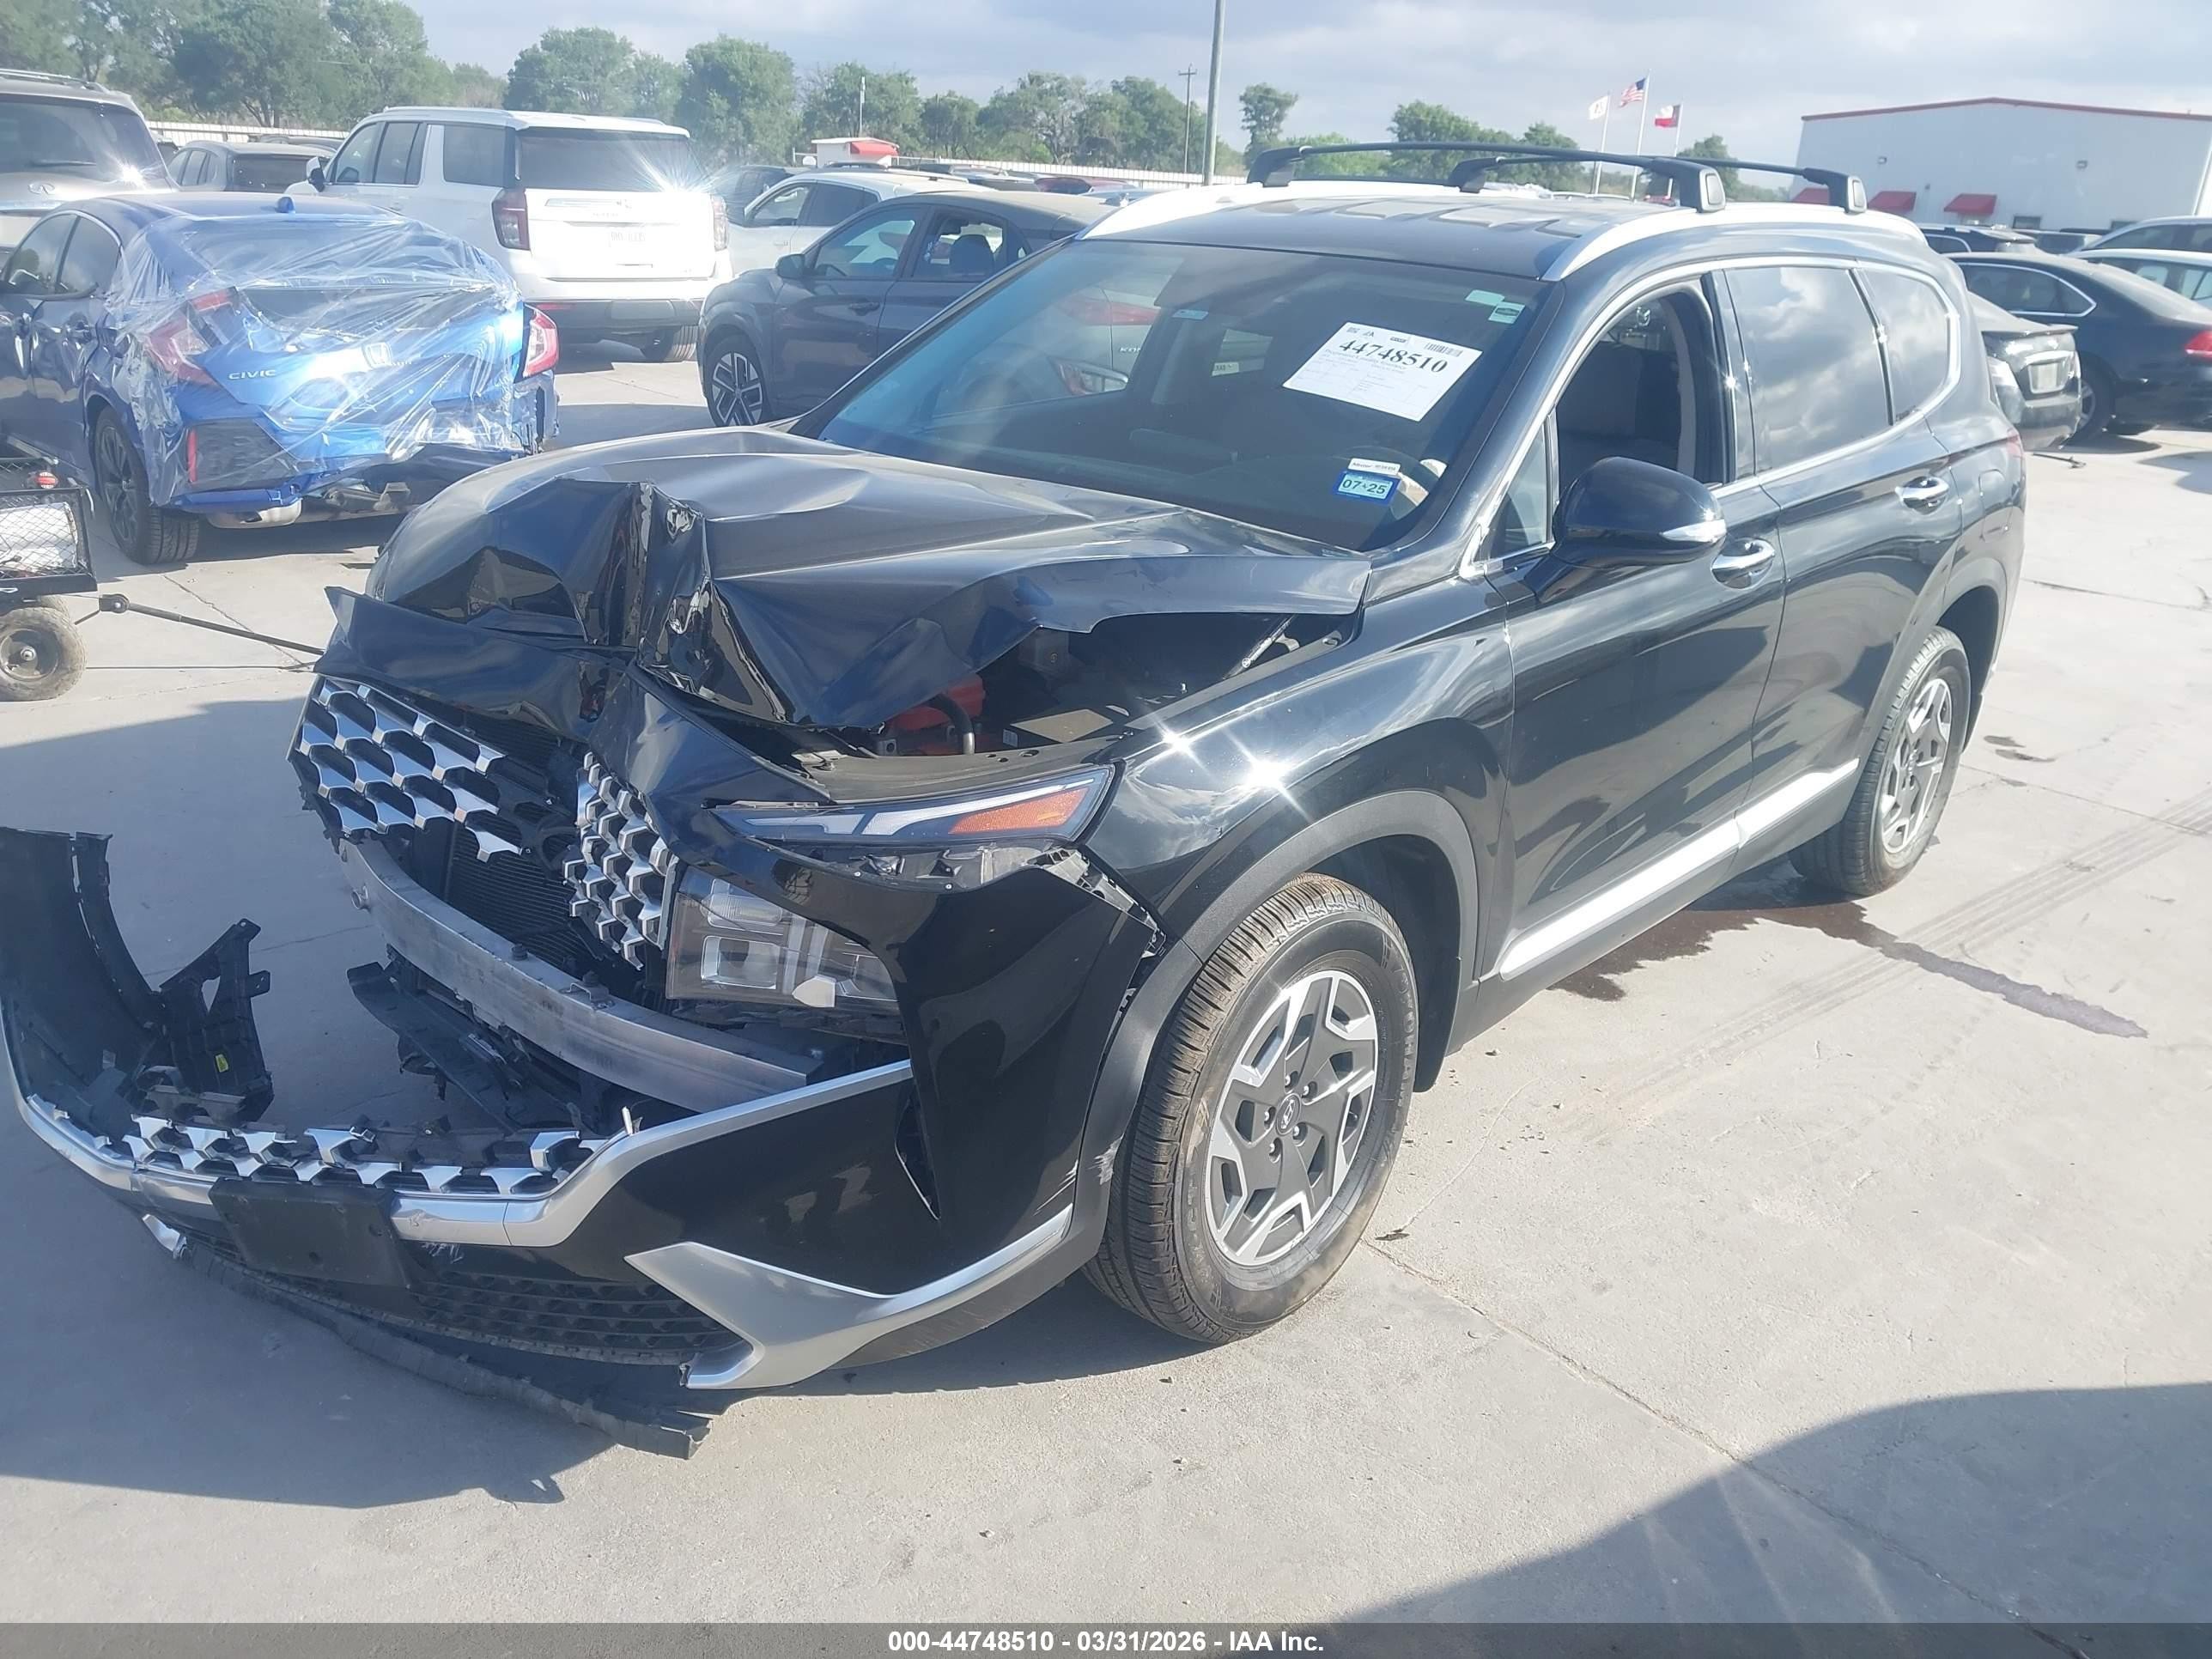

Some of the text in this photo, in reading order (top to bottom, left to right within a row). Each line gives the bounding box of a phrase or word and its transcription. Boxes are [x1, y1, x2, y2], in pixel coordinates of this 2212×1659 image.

[1340, 340, 1448, 373] 44748510
[228, 369, 276, 380] CIVIC
[1342, 479, 1388, 495] 07 25
